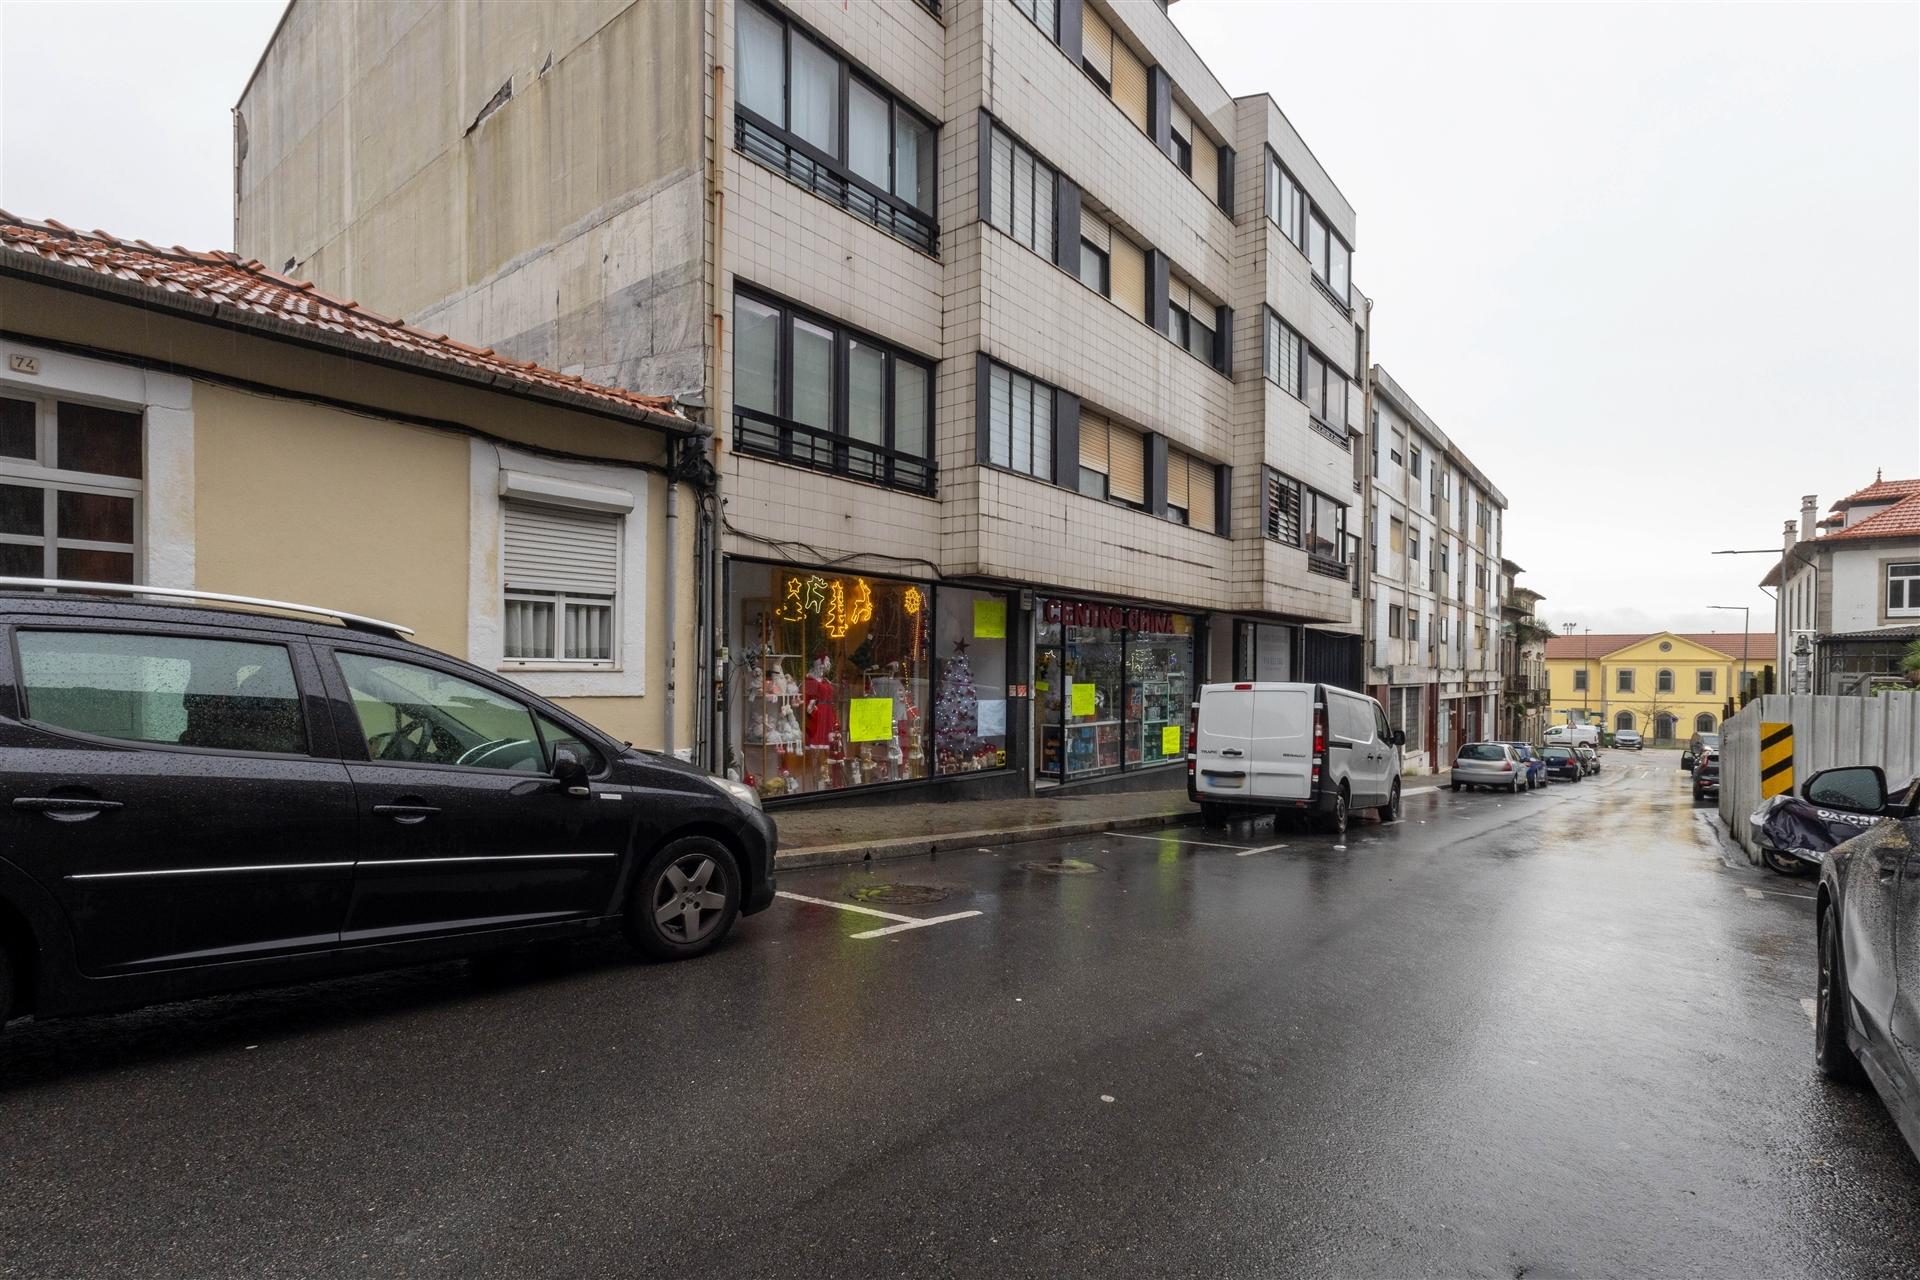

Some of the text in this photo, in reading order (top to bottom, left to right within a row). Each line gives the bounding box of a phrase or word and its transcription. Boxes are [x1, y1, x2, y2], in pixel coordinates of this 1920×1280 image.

[15, 356, 34, 370] 74
[1044, 599, 1175, 634] CENTRO CHINA
